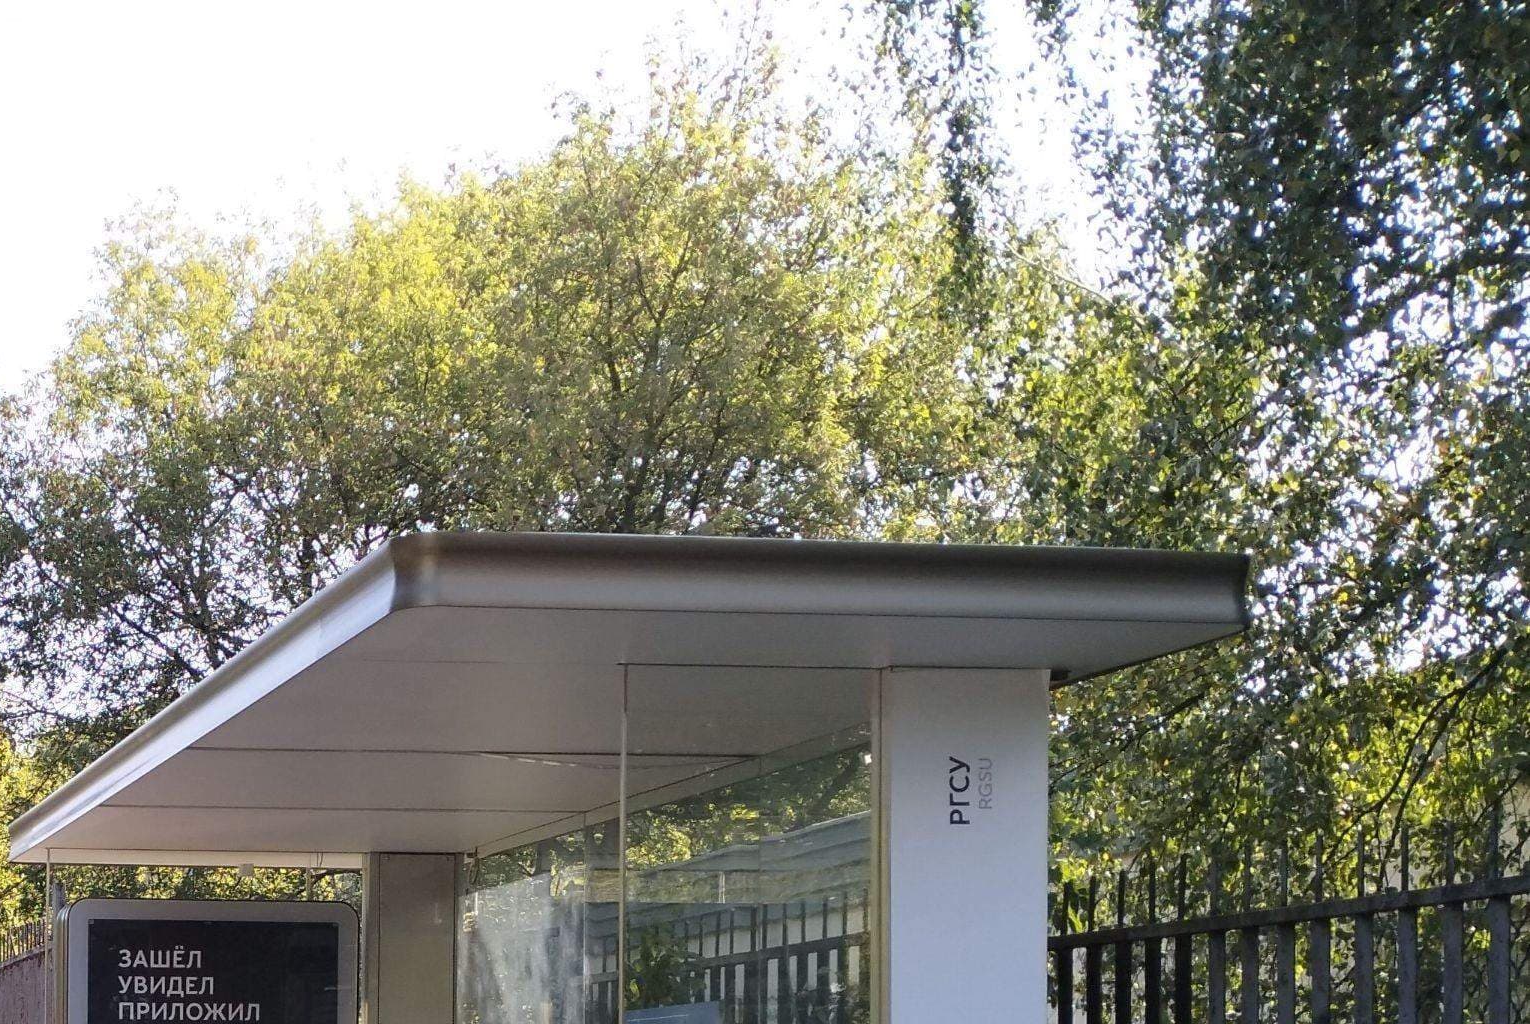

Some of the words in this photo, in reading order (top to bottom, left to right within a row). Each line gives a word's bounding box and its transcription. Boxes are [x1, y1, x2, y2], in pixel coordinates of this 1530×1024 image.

[949, 756, 970, 825] РГСУ
[979, 758, 993, 810] RGSU
[118, 945, 202, 968] ЗАШЁЛ
[118, 975, 214, 998] УВИДЕЛ
[118, 1001, 260, 1021] ПРИЛОЖИЛ
